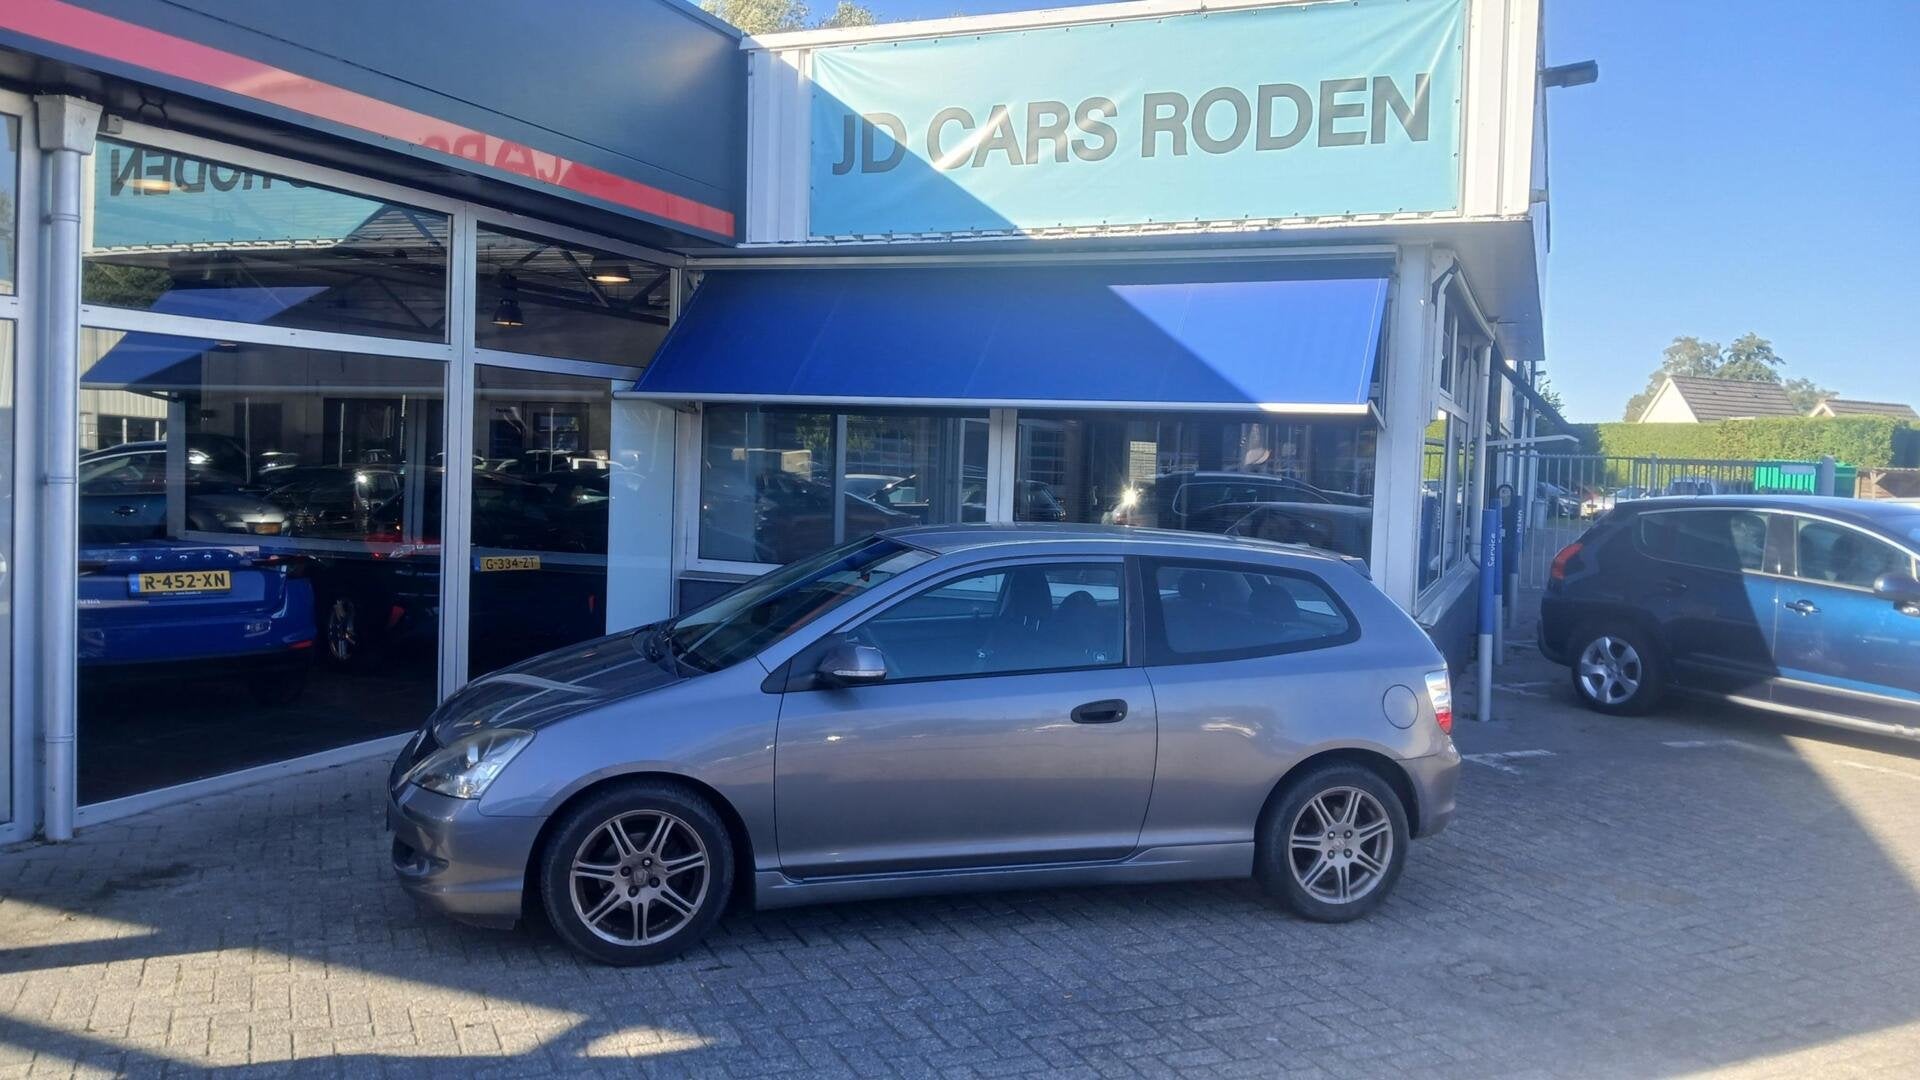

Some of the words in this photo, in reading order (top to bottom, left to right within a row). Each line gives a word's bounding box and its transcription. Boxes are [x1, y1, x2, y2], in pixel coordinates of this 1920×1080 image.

[832, 112, 907, 176] JD
[926, 96, 1118, 170] CARS
[1141, 73, 1431, 158] RODEN
[1487, 533, 1496, 567] Service
[144, 573, 226, 590] R-452-XN
